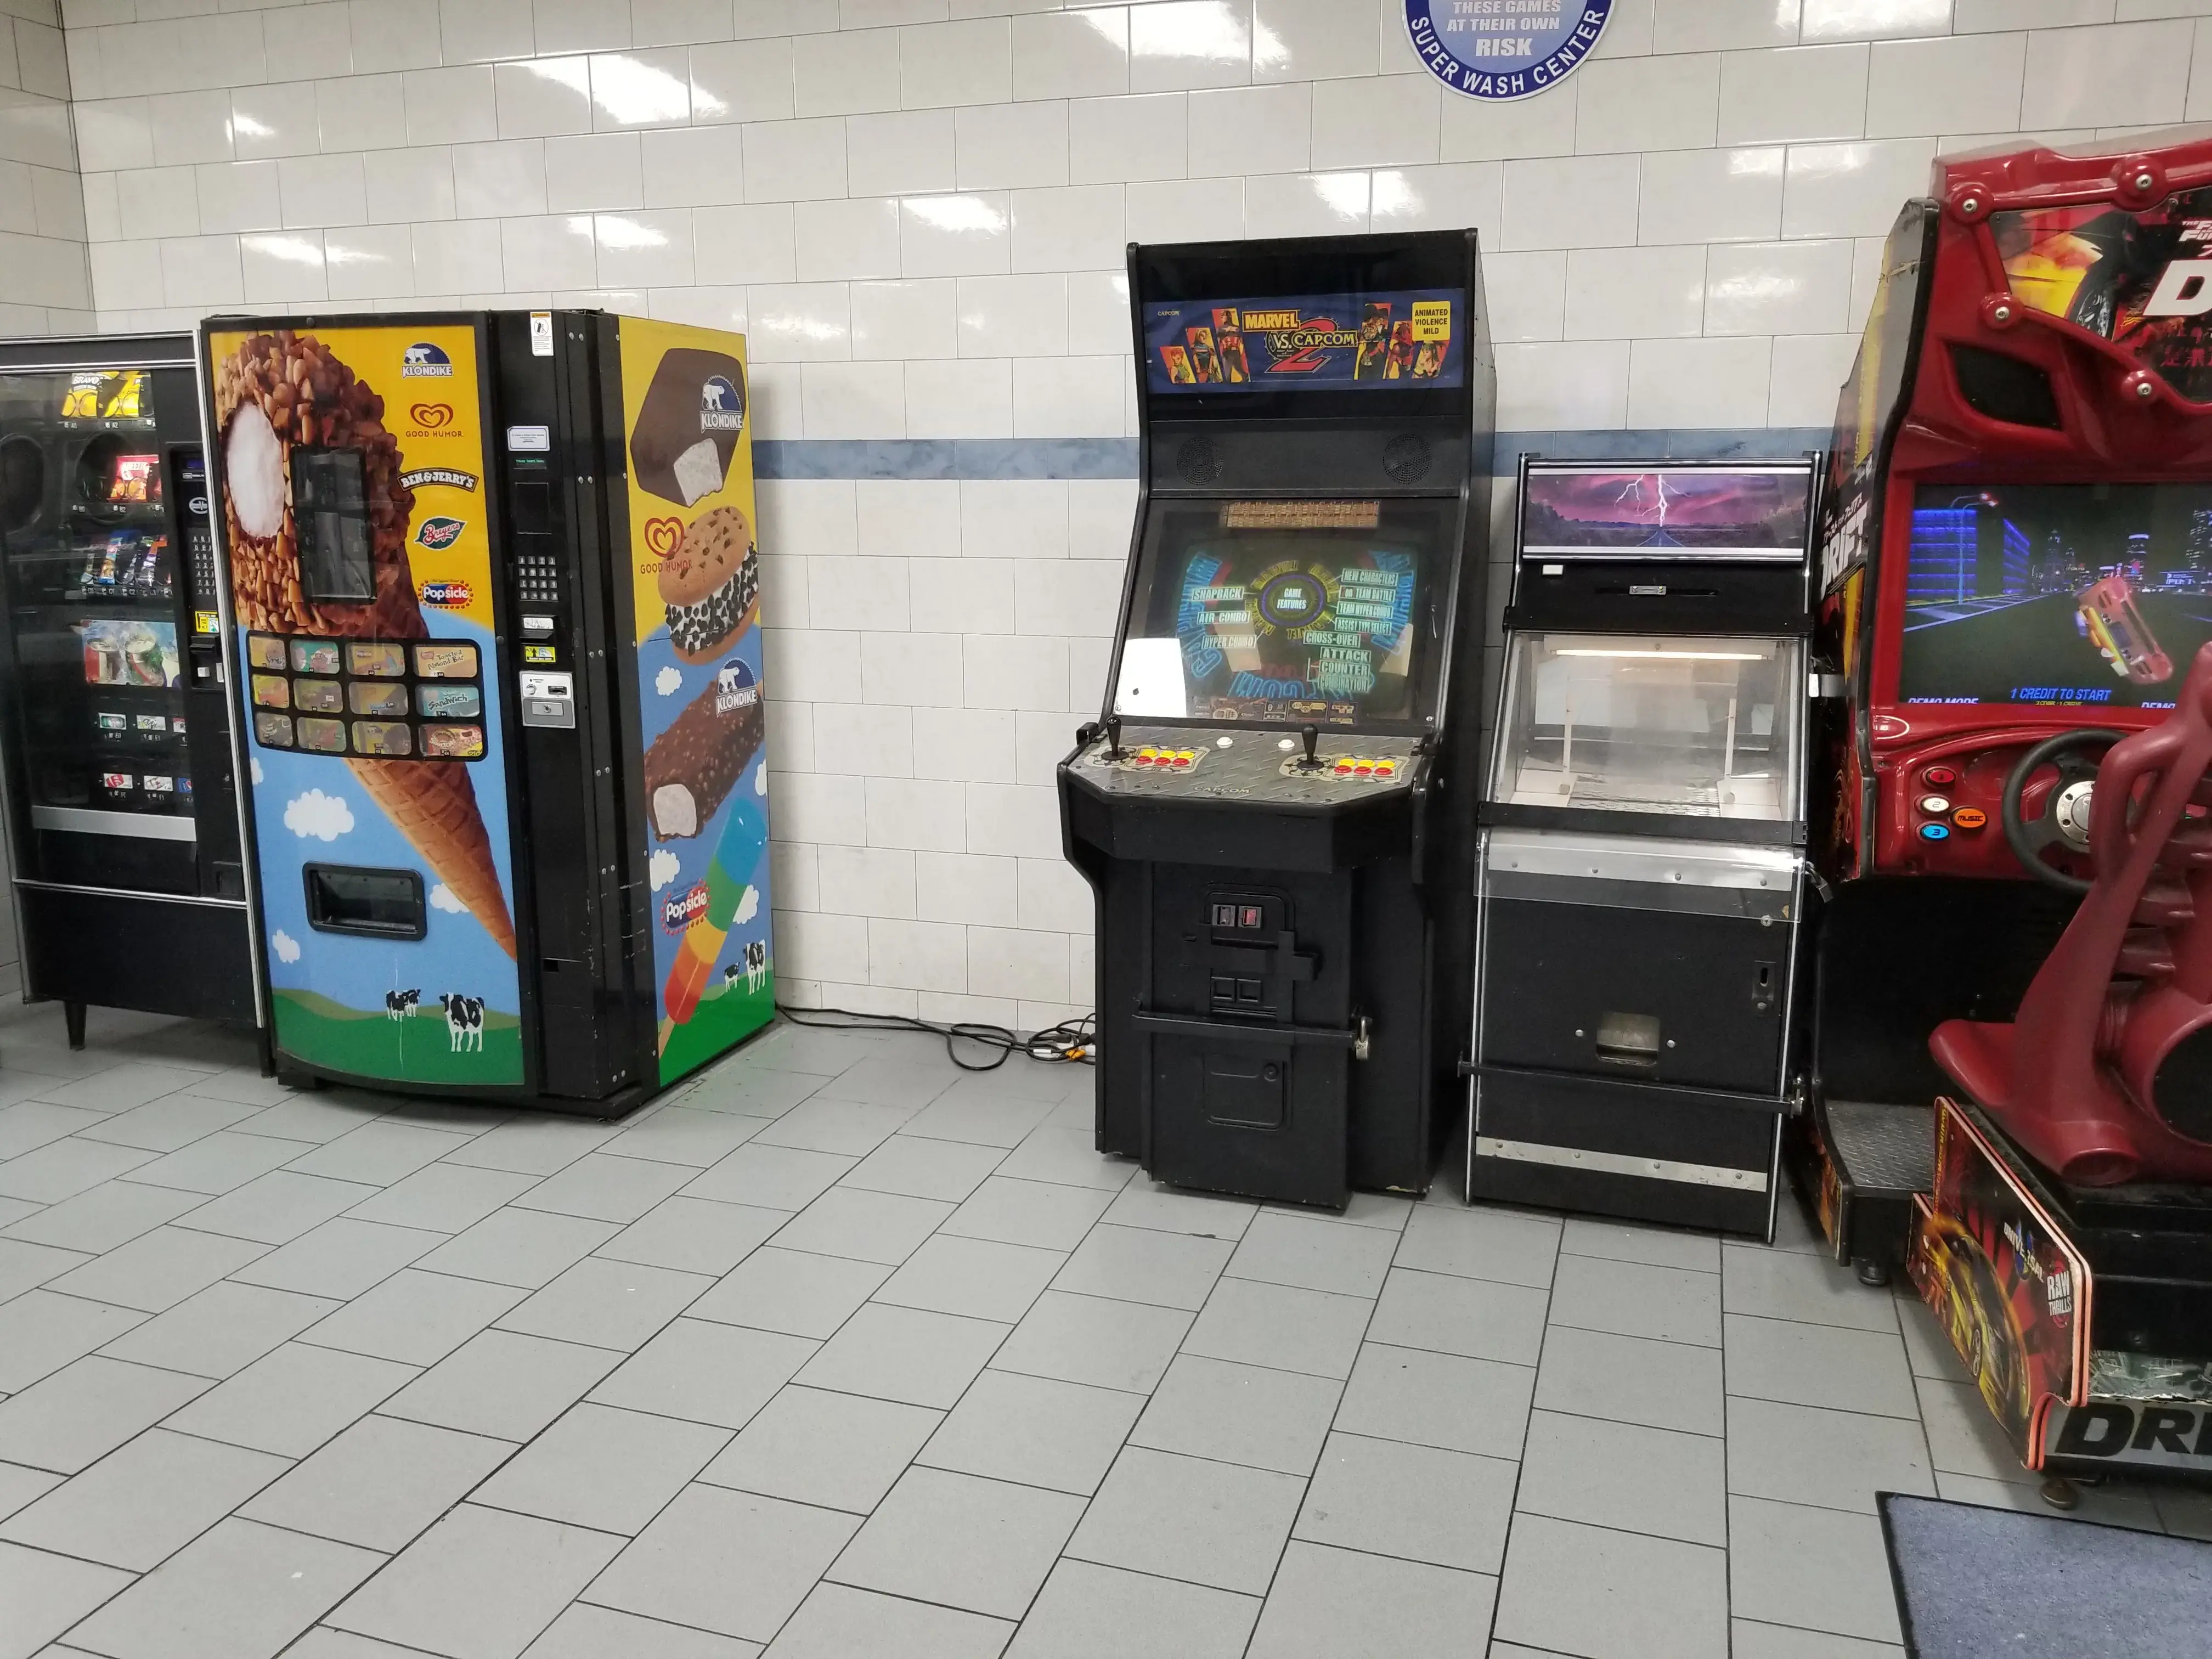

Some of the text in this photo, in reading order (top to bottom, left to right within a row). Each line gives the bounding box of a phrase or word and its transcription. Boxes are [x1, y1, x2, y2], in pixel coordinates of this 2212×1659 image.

[1453, 0, 1561, 15] THESE GAMES
[1447, 17, 1560, 32] AT THEIR OWN
[1412, 9, 1605, 95] SUPER WASH CENTER
[1475, 38, 1532, 57] RISK
[1415, 308, 1448, 317] ANIMATED
[1245, 313, 1298, 329] MARVEL
[1415, 318, 1448, 326] VIOLENCE
[1272, 332, 1355, 349] VS. CAPCOM
[402, 365, 453, 379] KLONDIKE
[701, 412, 743, 432] KLONDIKE
[424, 522, 460, 544] Breyers
[640, 560, 692, 574] GOOD HUMOR
[1344, 571, 1396, 585] NEW CHARACTERS
[423, 586, 469, 601] Popsicle
[1284, 588, 1302, 598] GAME
[1356, 589, 1371, 599] TEAM
[1372, 590, 1392, 601] BATTLE
[1277, 599, 1307, 610] FEATURES
[1340, 603, 1354, 613] TEAM
[1355, 605, 1372, 615] HYPER
[1199, 611, 1248, 624] AIR COMBO
[1338, 620, 1357, 631] ASSIST
[1205, 636, 1227, 649] HYPER
[1306, 633, 1359, 647] CROSS-OVER
[436, 650, 462, 661] Toasted
[1323, 648, 1368, 661] ATTACK
[427, 654, 464, 671] Almond Bar
[1321, 661, 1368, 675] COUNTER
[2011, 687, 2112, 701] 1 CREDIT TO START
[428, 693, 468, 711] Sandwich
[716, 689, 757, 715] KLONDIKE
[665, 889, 708, 923] Popsicle
[2047, 1270, 2070, 1301] RAW
[2048, 1296, 2073, 1316] THRILLS
